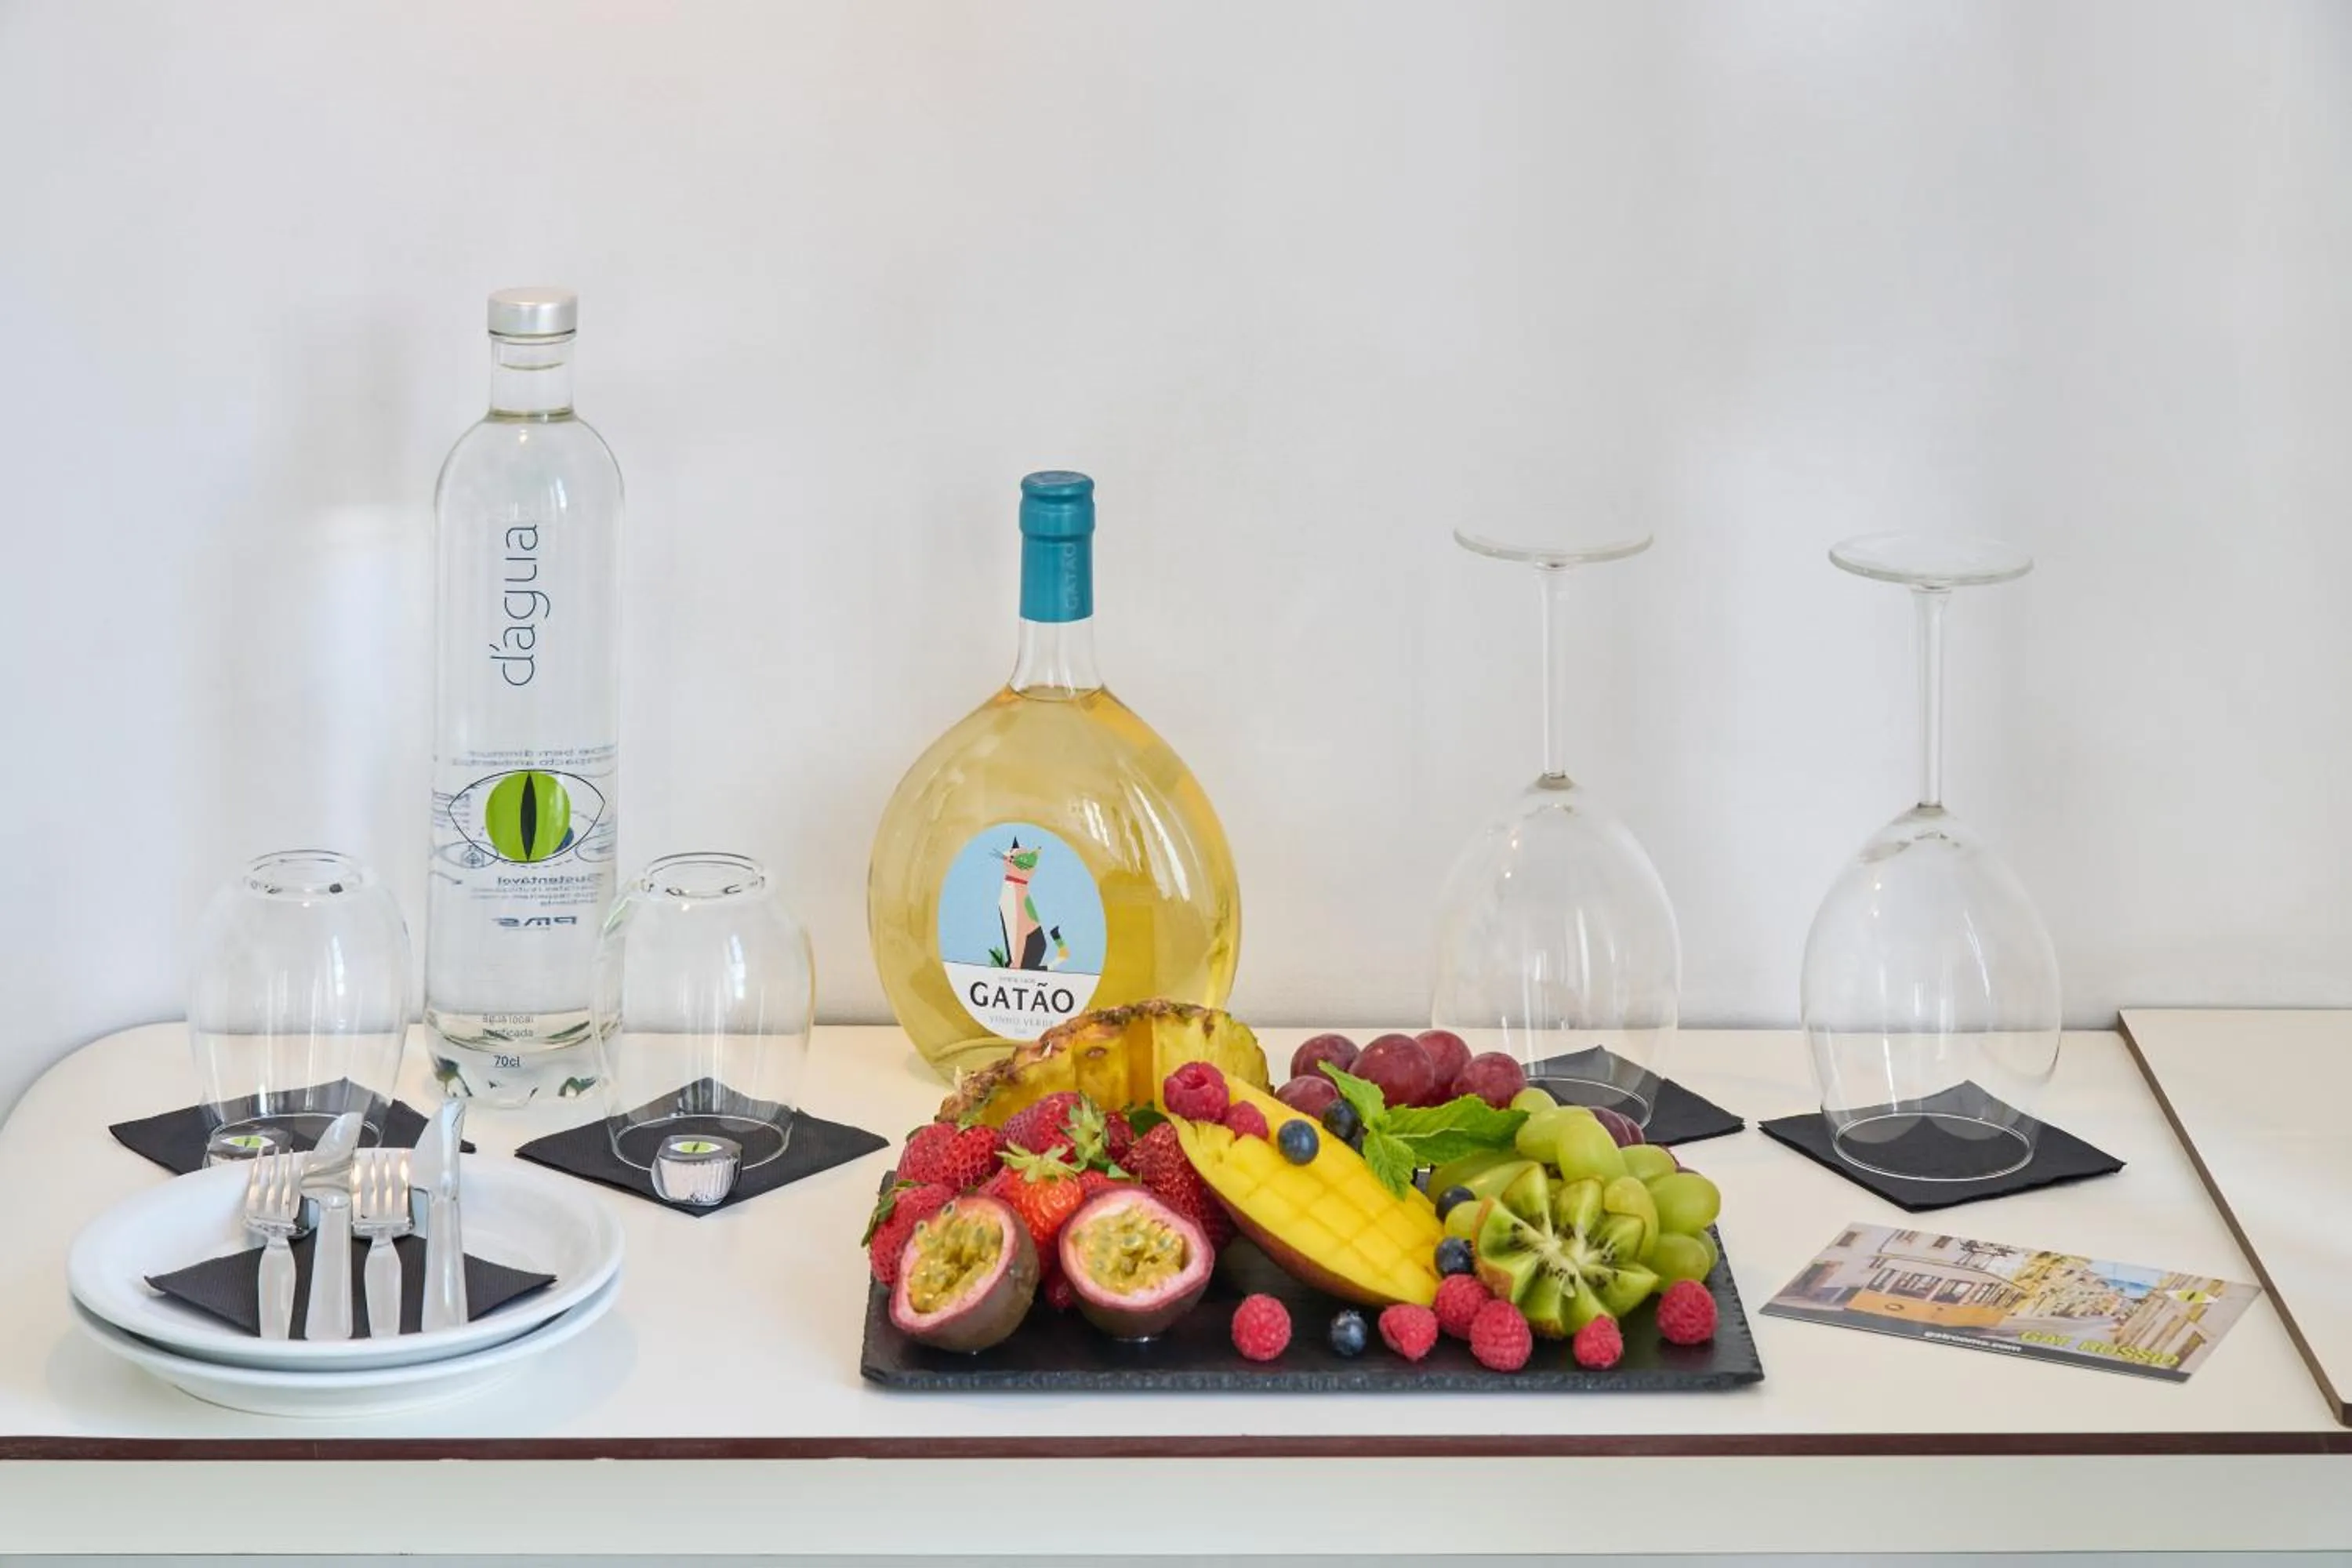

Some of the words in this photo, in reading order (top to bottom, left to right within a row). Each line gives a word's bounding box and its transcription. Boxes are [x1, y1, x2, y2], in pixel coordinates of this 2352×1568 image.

[969, 982, 1075, 1014] GATÃO
[989, 1014, 1020, 1025] VINHO
[493, 1054, 521, 1068] 70cl
[2018, 1330, 2073, 1348] GAT
[2077, 1338, 2180, 1367] ROSSIO
